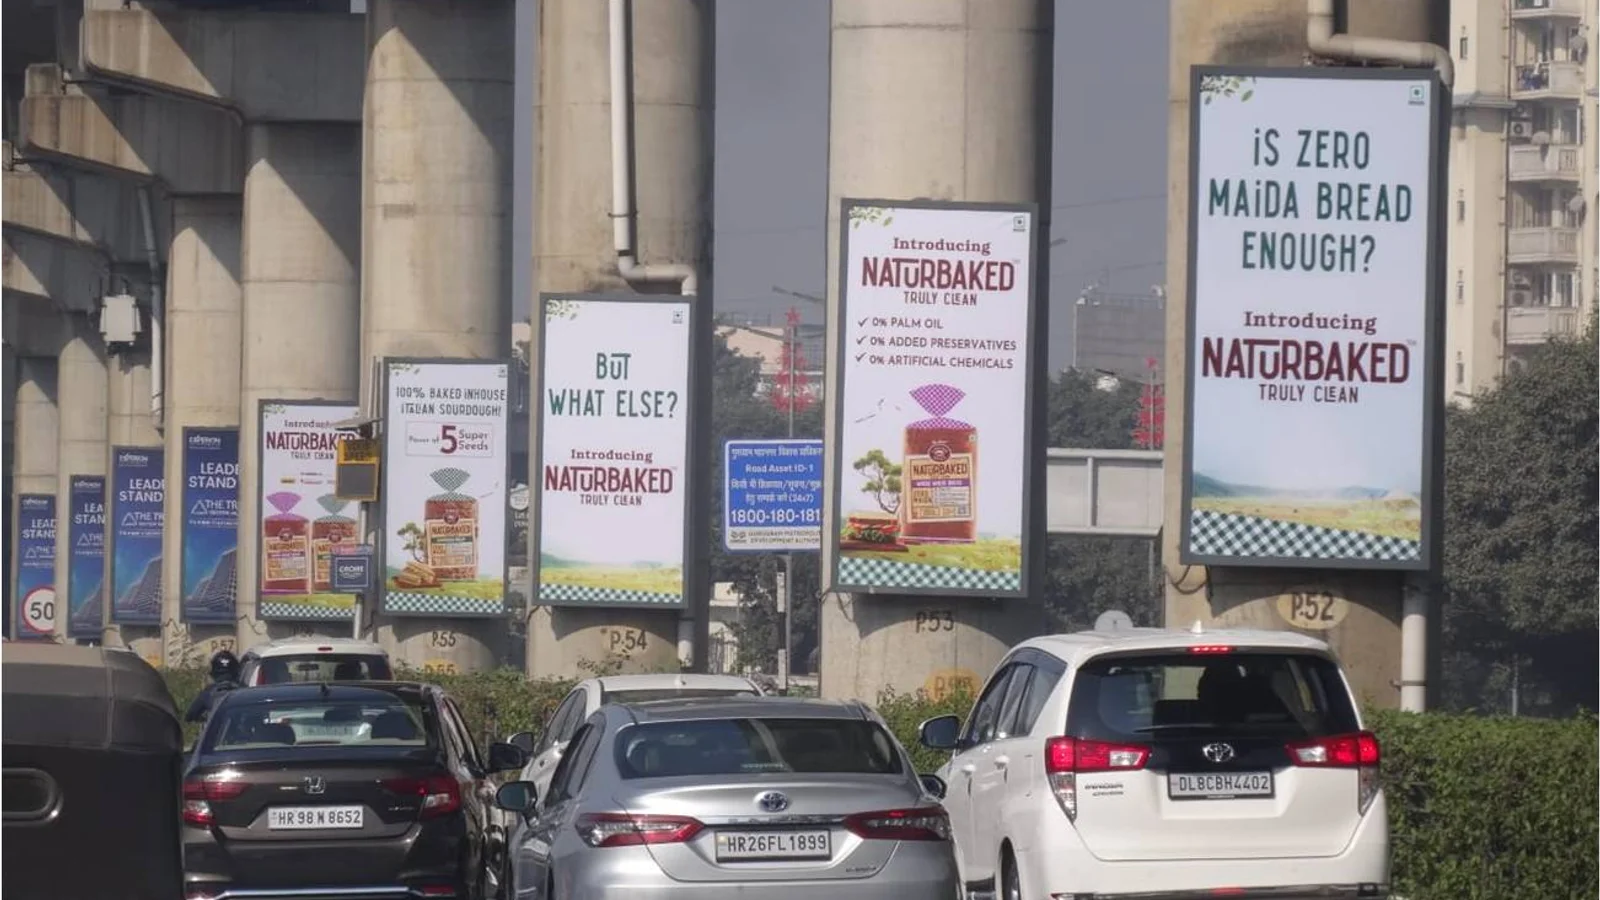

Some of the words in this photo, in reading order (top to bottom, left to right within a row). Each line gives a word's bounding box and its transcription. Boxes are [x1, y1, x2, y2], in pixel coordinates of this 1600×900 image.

[1296, 130, 1370, 170] ZERO
[1316, 181, 1412, 222] BREAD
[893, 237, 992, 256] Introducing
[1241, 231, 1376, 273] ENOUGH?
[862, 256, 1015, 291] NATURBAKED
[904, 291, 938, 305] TRULY
[944, 292, 978, 306] CLEAN
[872, 317, 887, 328] 0%
[891, 317, 921, 329] PALM
[924, 318, 944, 330] OIL
[1243, 311, 1377, 336] Introducing
[870, 337, 885, 347] 0%
[889, 336, 927, 348] ADDED
[930, 337, 1017, 351] PRESERVATIVES
[870, 355, 885, 366] 0%
[888, 354, 946, 367] ARTIFICIAL
[949, 357, 1013, 369] CHEMICALS
[1202, 336, 1410, 383] NATURBAKED
[396, 386, 425, 399] 100%
[429, 387, 461, 400] BAKED
[1259, 384, 1305, 402] TRULY
[1313, 385, 1359, 404] CLEAN
[440, 403, 502, 417] SOURDOUGH!
[548, 388, 605, 417] WHAT
[616, 390, 678, 418] ELSE?
[440, 425, 457, 454] 5
[458, 429, 488, 440] Super
[458, 440, 488, 451] Seeds
[570, 449, 654, 464] Introducing
[745, 463, 767, 473] Road
[188, 476, 236, 489] STAND
[545, 465, 674, 494] NATURBAKED
[119, 490, 164, 502] STAND
[580, 494, 609, 506] TRULY
[614, 494, 643, 506] CLEAN
[205, 499, 225, 509] THE
[134, 511, 152, 521] THE
[731, 508, 820, 523] 1800-180-181
[30, 601, 55, 620] 50
[1291, 591, 1334, 621] P.52
[915, 610, 954, 633] P.53
[610, 629, 648, 650] P.54
[278, 812, 294, 825] HR
[297, 811, 314, 825] 98
[328, 810, 361, 824] 8652
[727, 834, 827, 852] HR26FL1899
